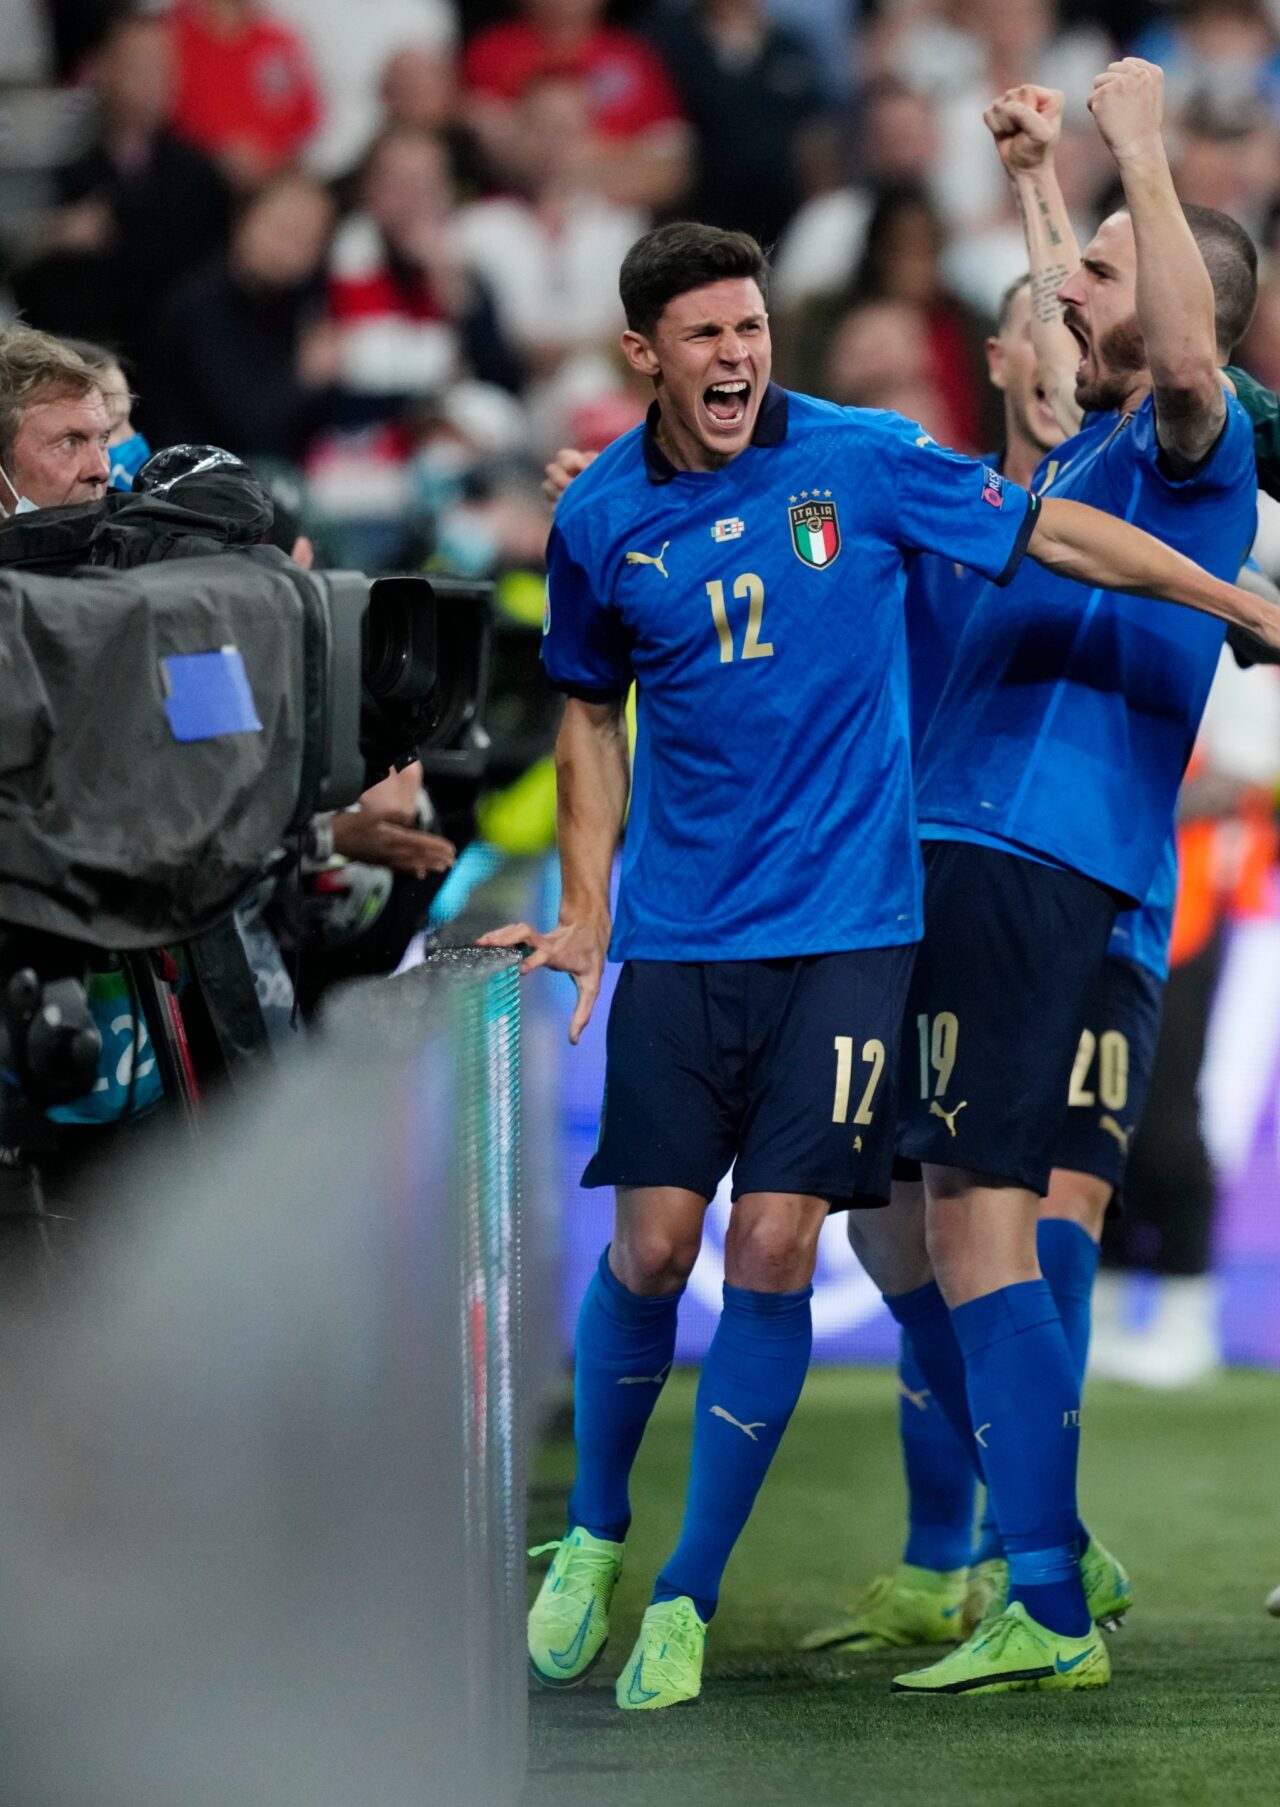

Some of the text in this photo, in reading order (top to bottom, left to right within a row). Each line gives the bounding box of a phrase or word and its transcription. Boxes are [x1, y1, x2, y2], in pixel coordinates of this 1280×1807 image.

[793, 506, 833, 520] ITALIA
[705, 572, 774, 663] 12
[832, 1035, 885, 1125] 12
[917, 1011, 959, 1100] 19
[1067, 1027, 1129, 1111] 20
